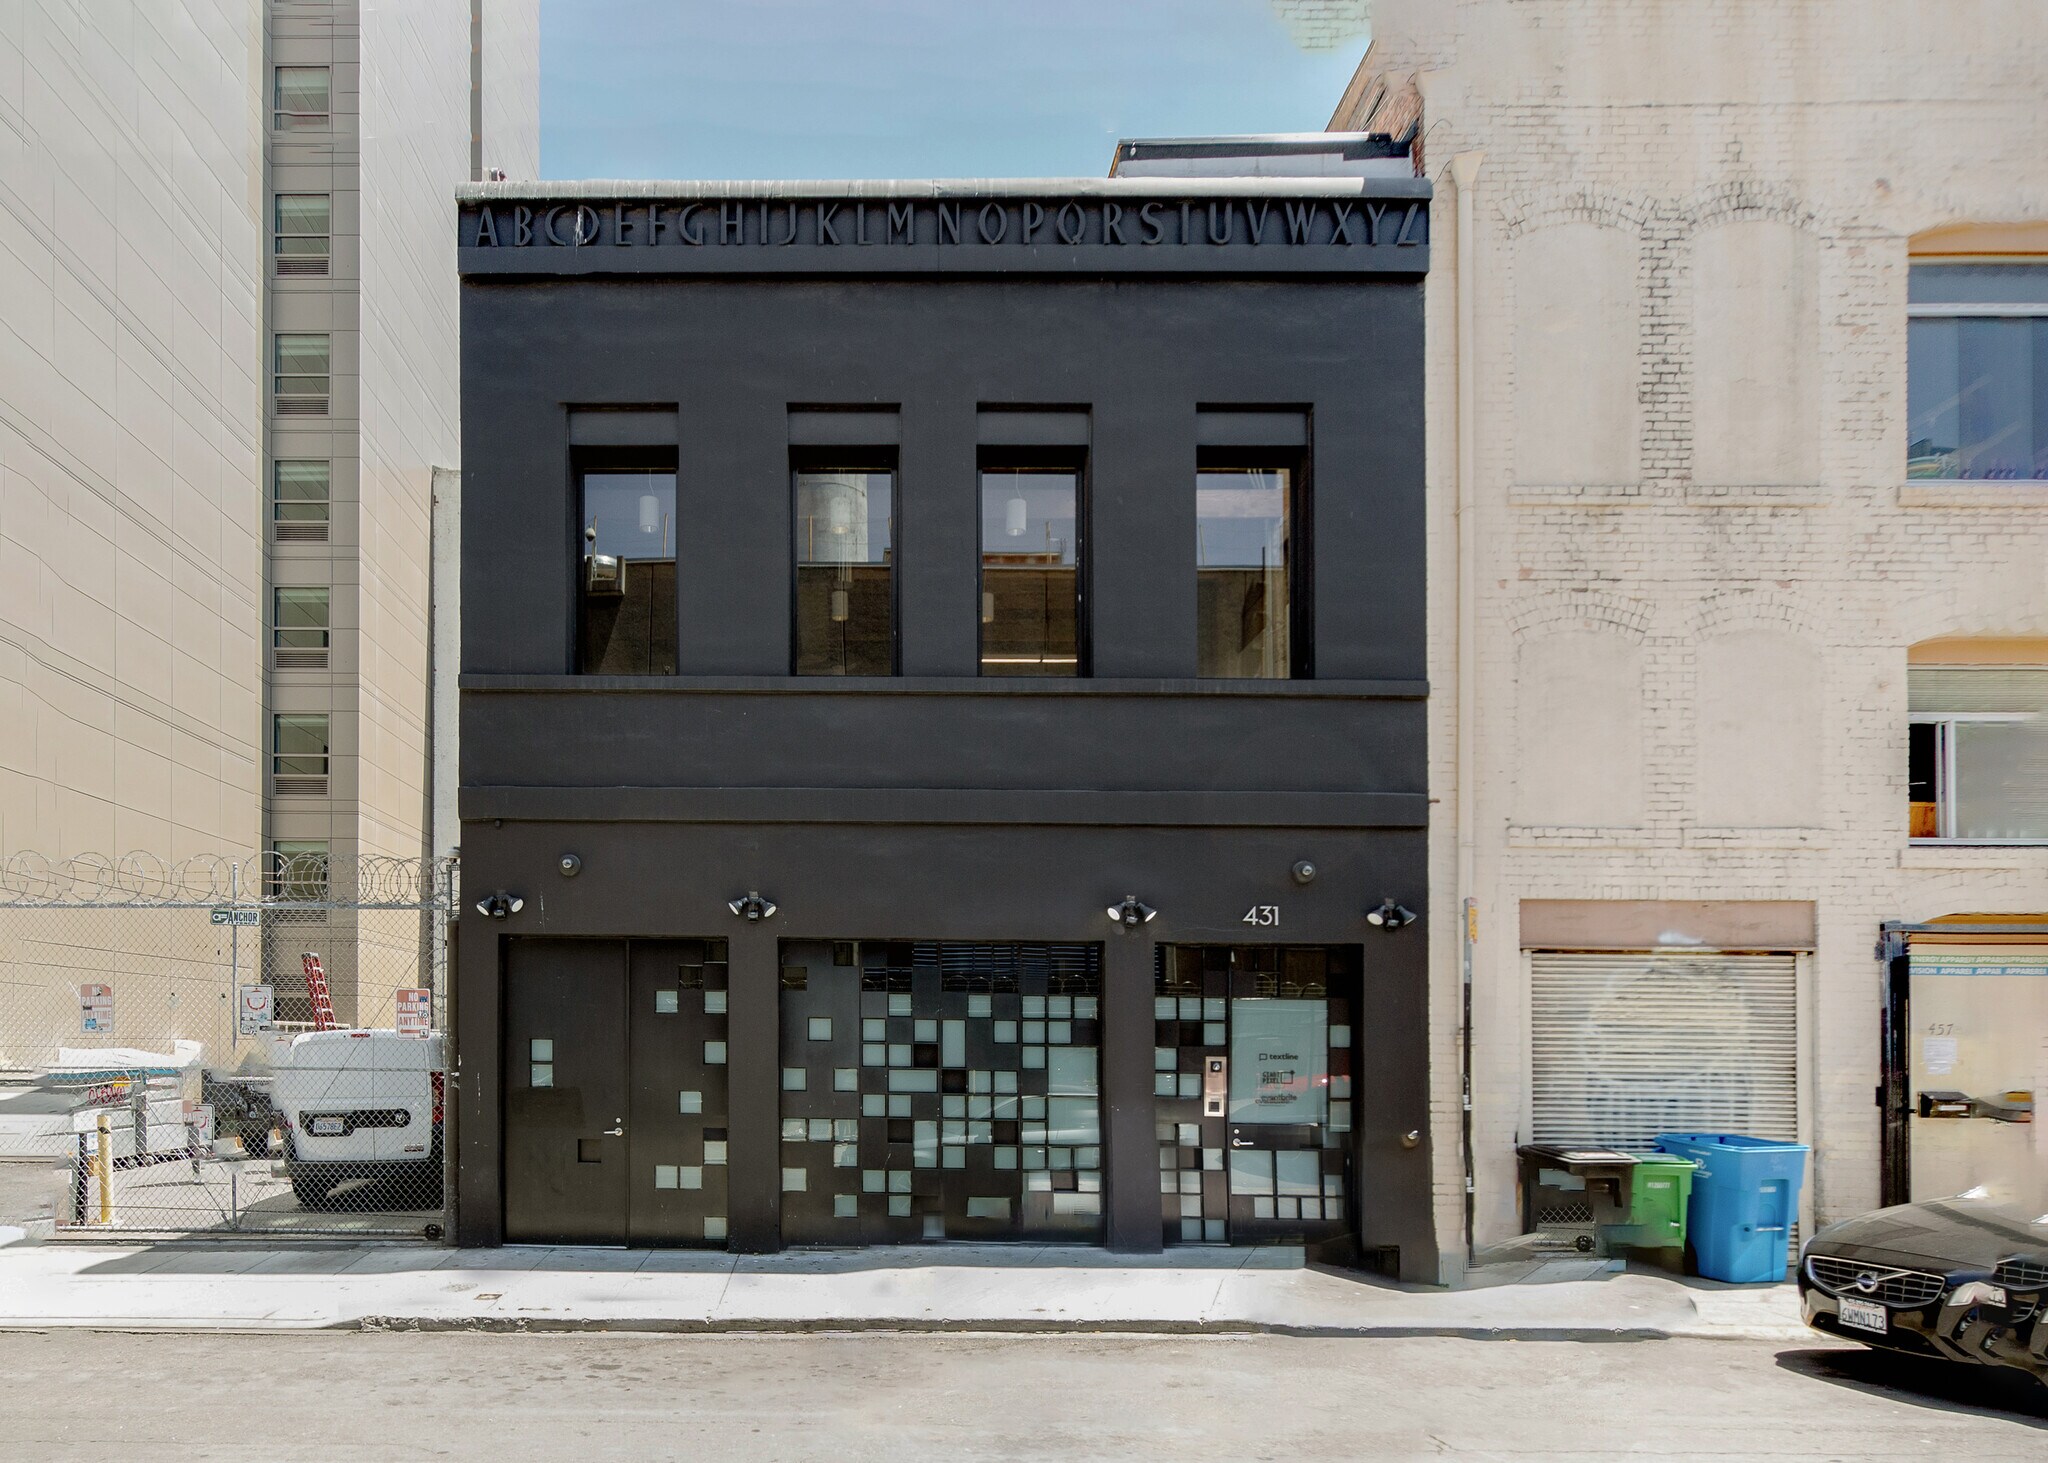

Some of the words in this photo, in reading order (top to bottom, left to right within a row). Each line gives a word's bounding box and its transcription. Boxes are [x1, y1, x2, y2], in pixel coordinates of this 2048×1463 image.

[228, 910, 258, 925] ANCHOR
[1242, 905, 1279, 926] 431
[408, 992, 419, 1002] NO
[397, 1002, 429, 1012] PARKING
[399, 1016, 429, 1026] ANYTIME
[1928, 1023, 1954, 1036] 457
[1841, 1307, 1885, 1329] 6WMN173
